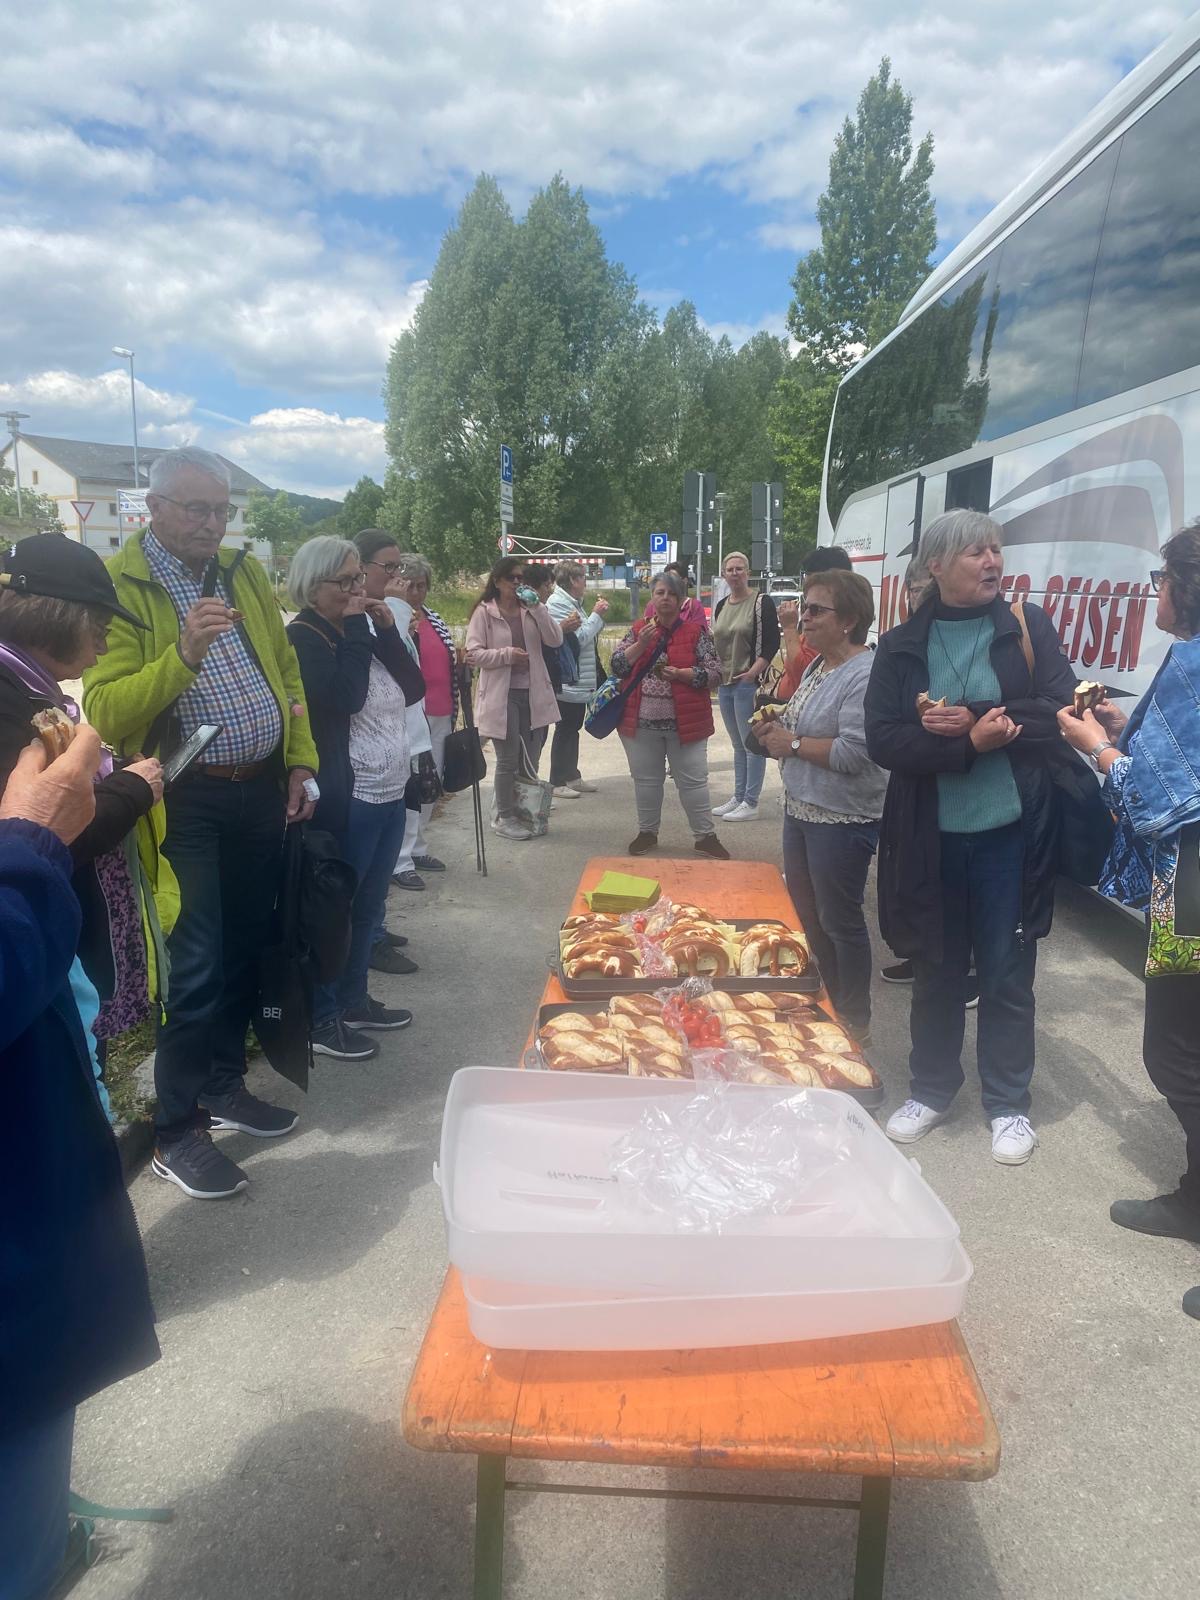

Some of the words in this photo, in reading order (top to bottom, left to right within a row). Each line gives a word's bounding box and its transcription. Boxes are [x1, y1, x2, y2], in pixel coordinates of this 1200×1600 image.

[503, 450, 510, 476] P
[654, 536, 664, 551] P
[1042, 575, 1150, 671] REISEN
